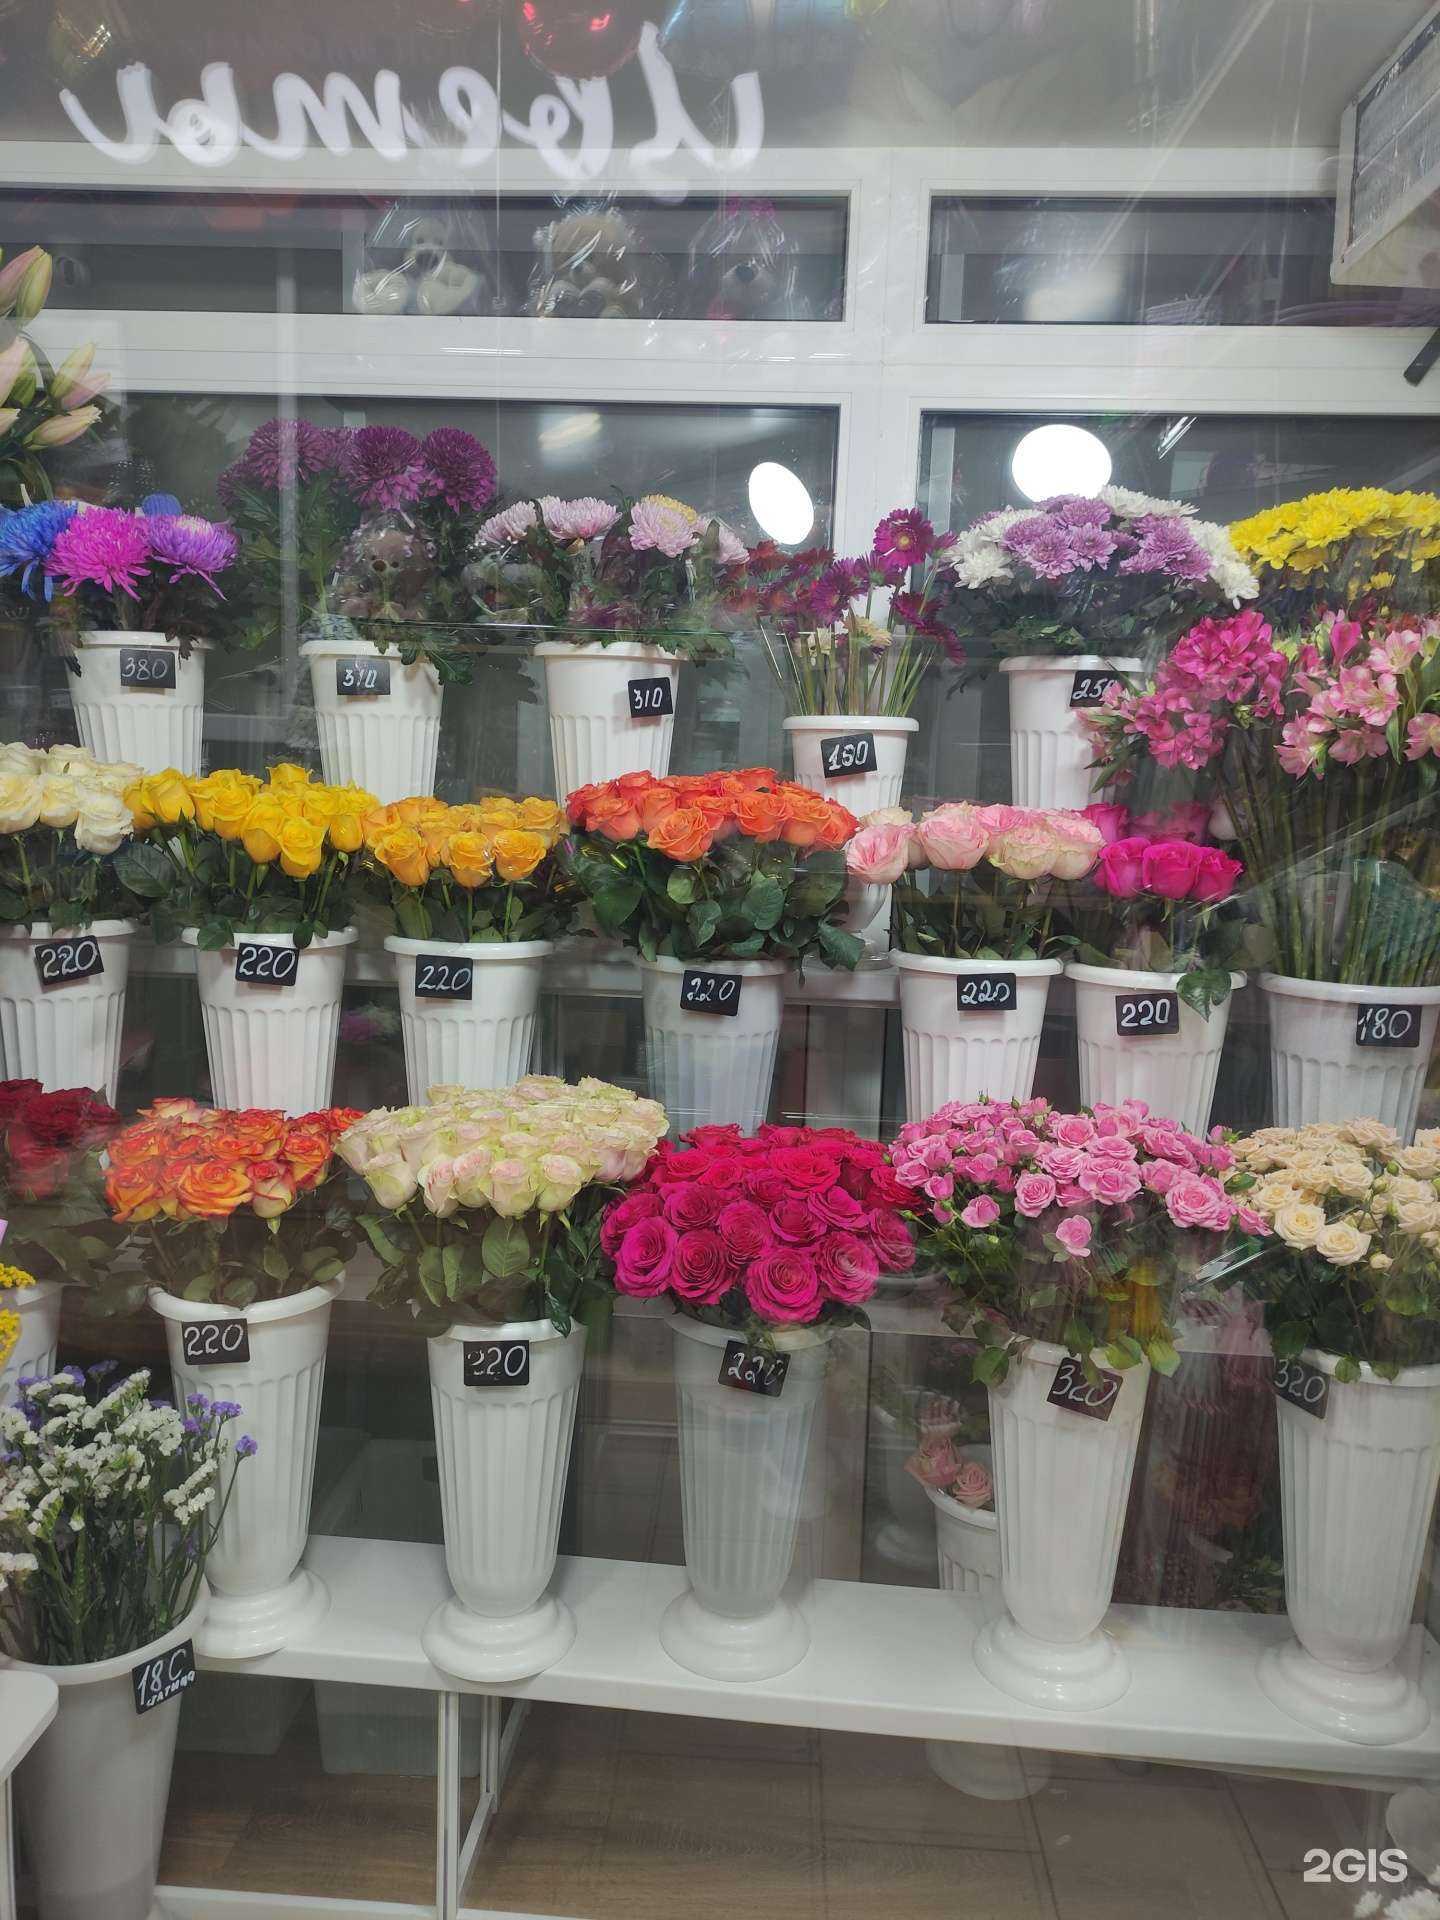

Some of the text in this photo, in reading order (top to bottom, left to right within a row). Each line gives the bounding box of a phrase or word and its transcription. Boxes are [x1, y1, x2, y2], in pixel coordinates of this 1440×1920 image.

[122, 657, 169, 681] 380
[342, 669, 378, 689] 310
[633, 686, 663, 711] 310
[40, 940, 98, 979] 220
[239, 946, 296, 979] 220
[416, 965, 471, 991] 220
[686, 977, 736, 1002] 220
[960, 979, 1011, 1005] 220
[1120, 998, 1171, 1028] 220
[1358, 1007, 1412, 1041] 180
[184, 1324, 244, 1356] 220
[467, 1345, 528, 1377] 220
[1052, 1364, 1118, 1407] 320
[1273, 1358, 1327, 1403] 320
